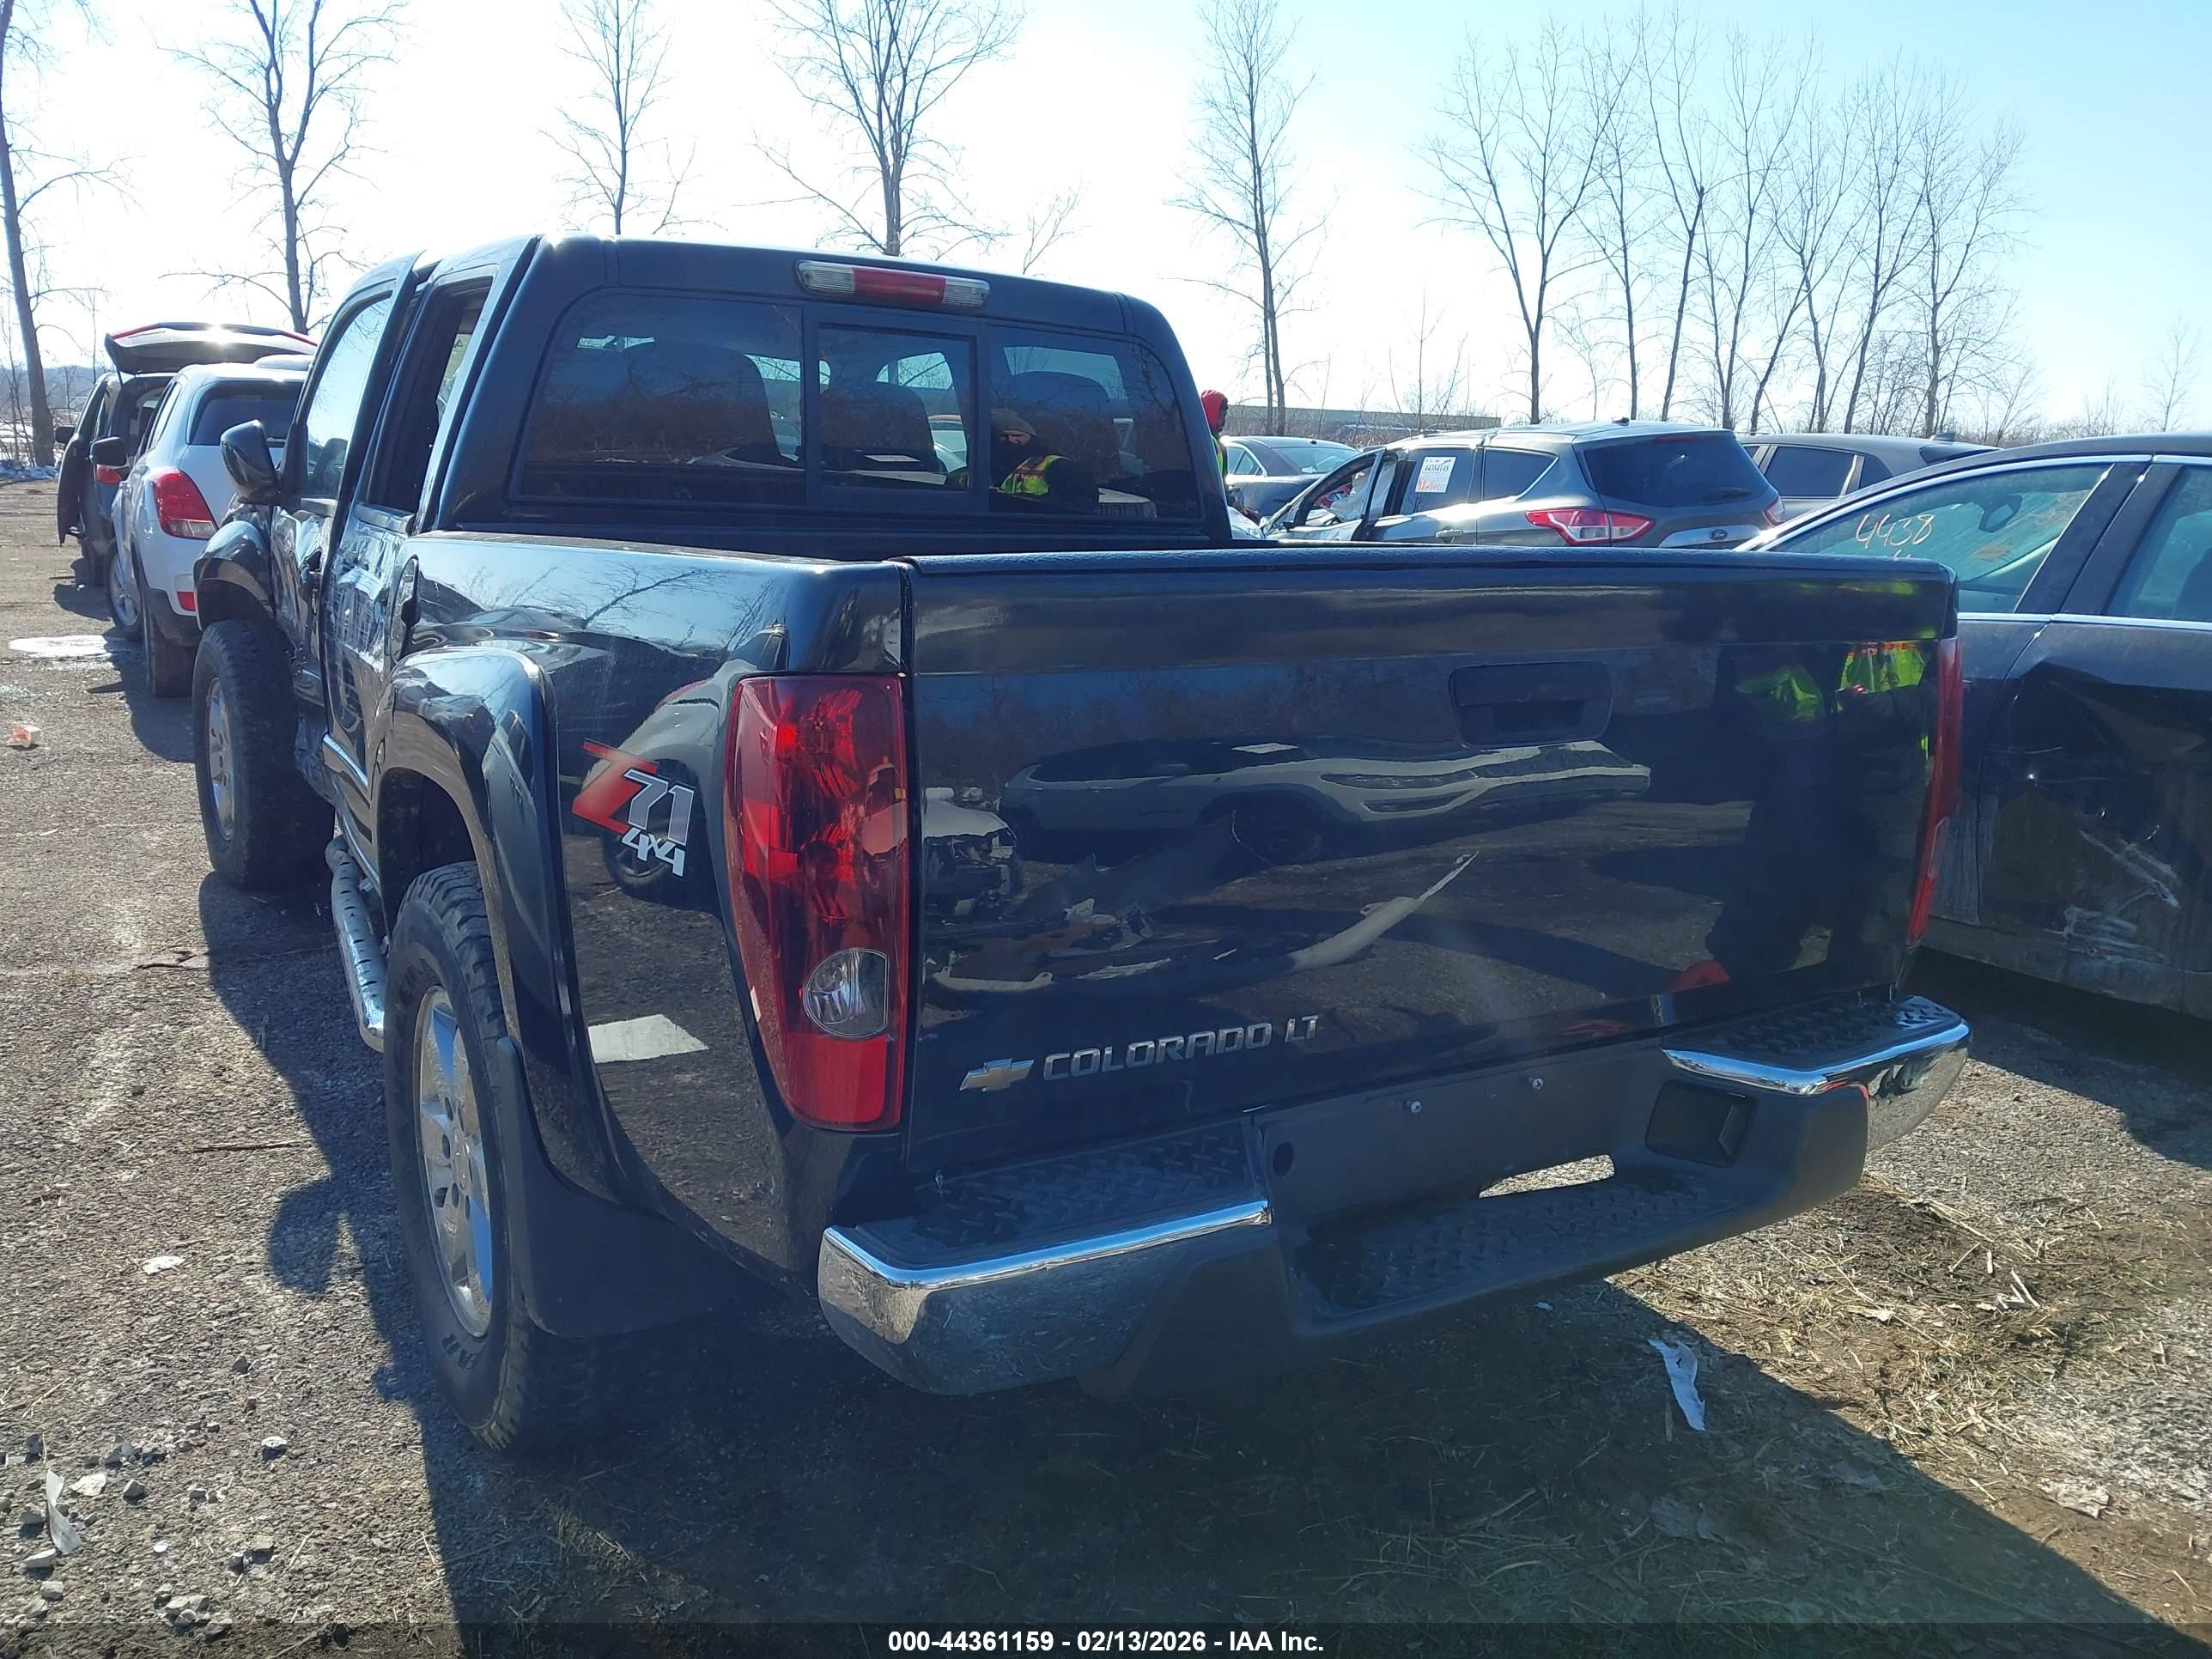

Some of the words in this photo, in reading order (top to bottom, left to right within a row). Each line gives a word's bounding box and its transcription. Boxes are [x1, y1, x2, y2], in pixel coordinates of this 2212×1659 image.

[1856, 514, 1936, 550] 4438
[571, 738, 695, 847] Z71
[1042, 1022, 1273, 1082] COLORADO
[1284, 1015, 1320, 1043] LT
